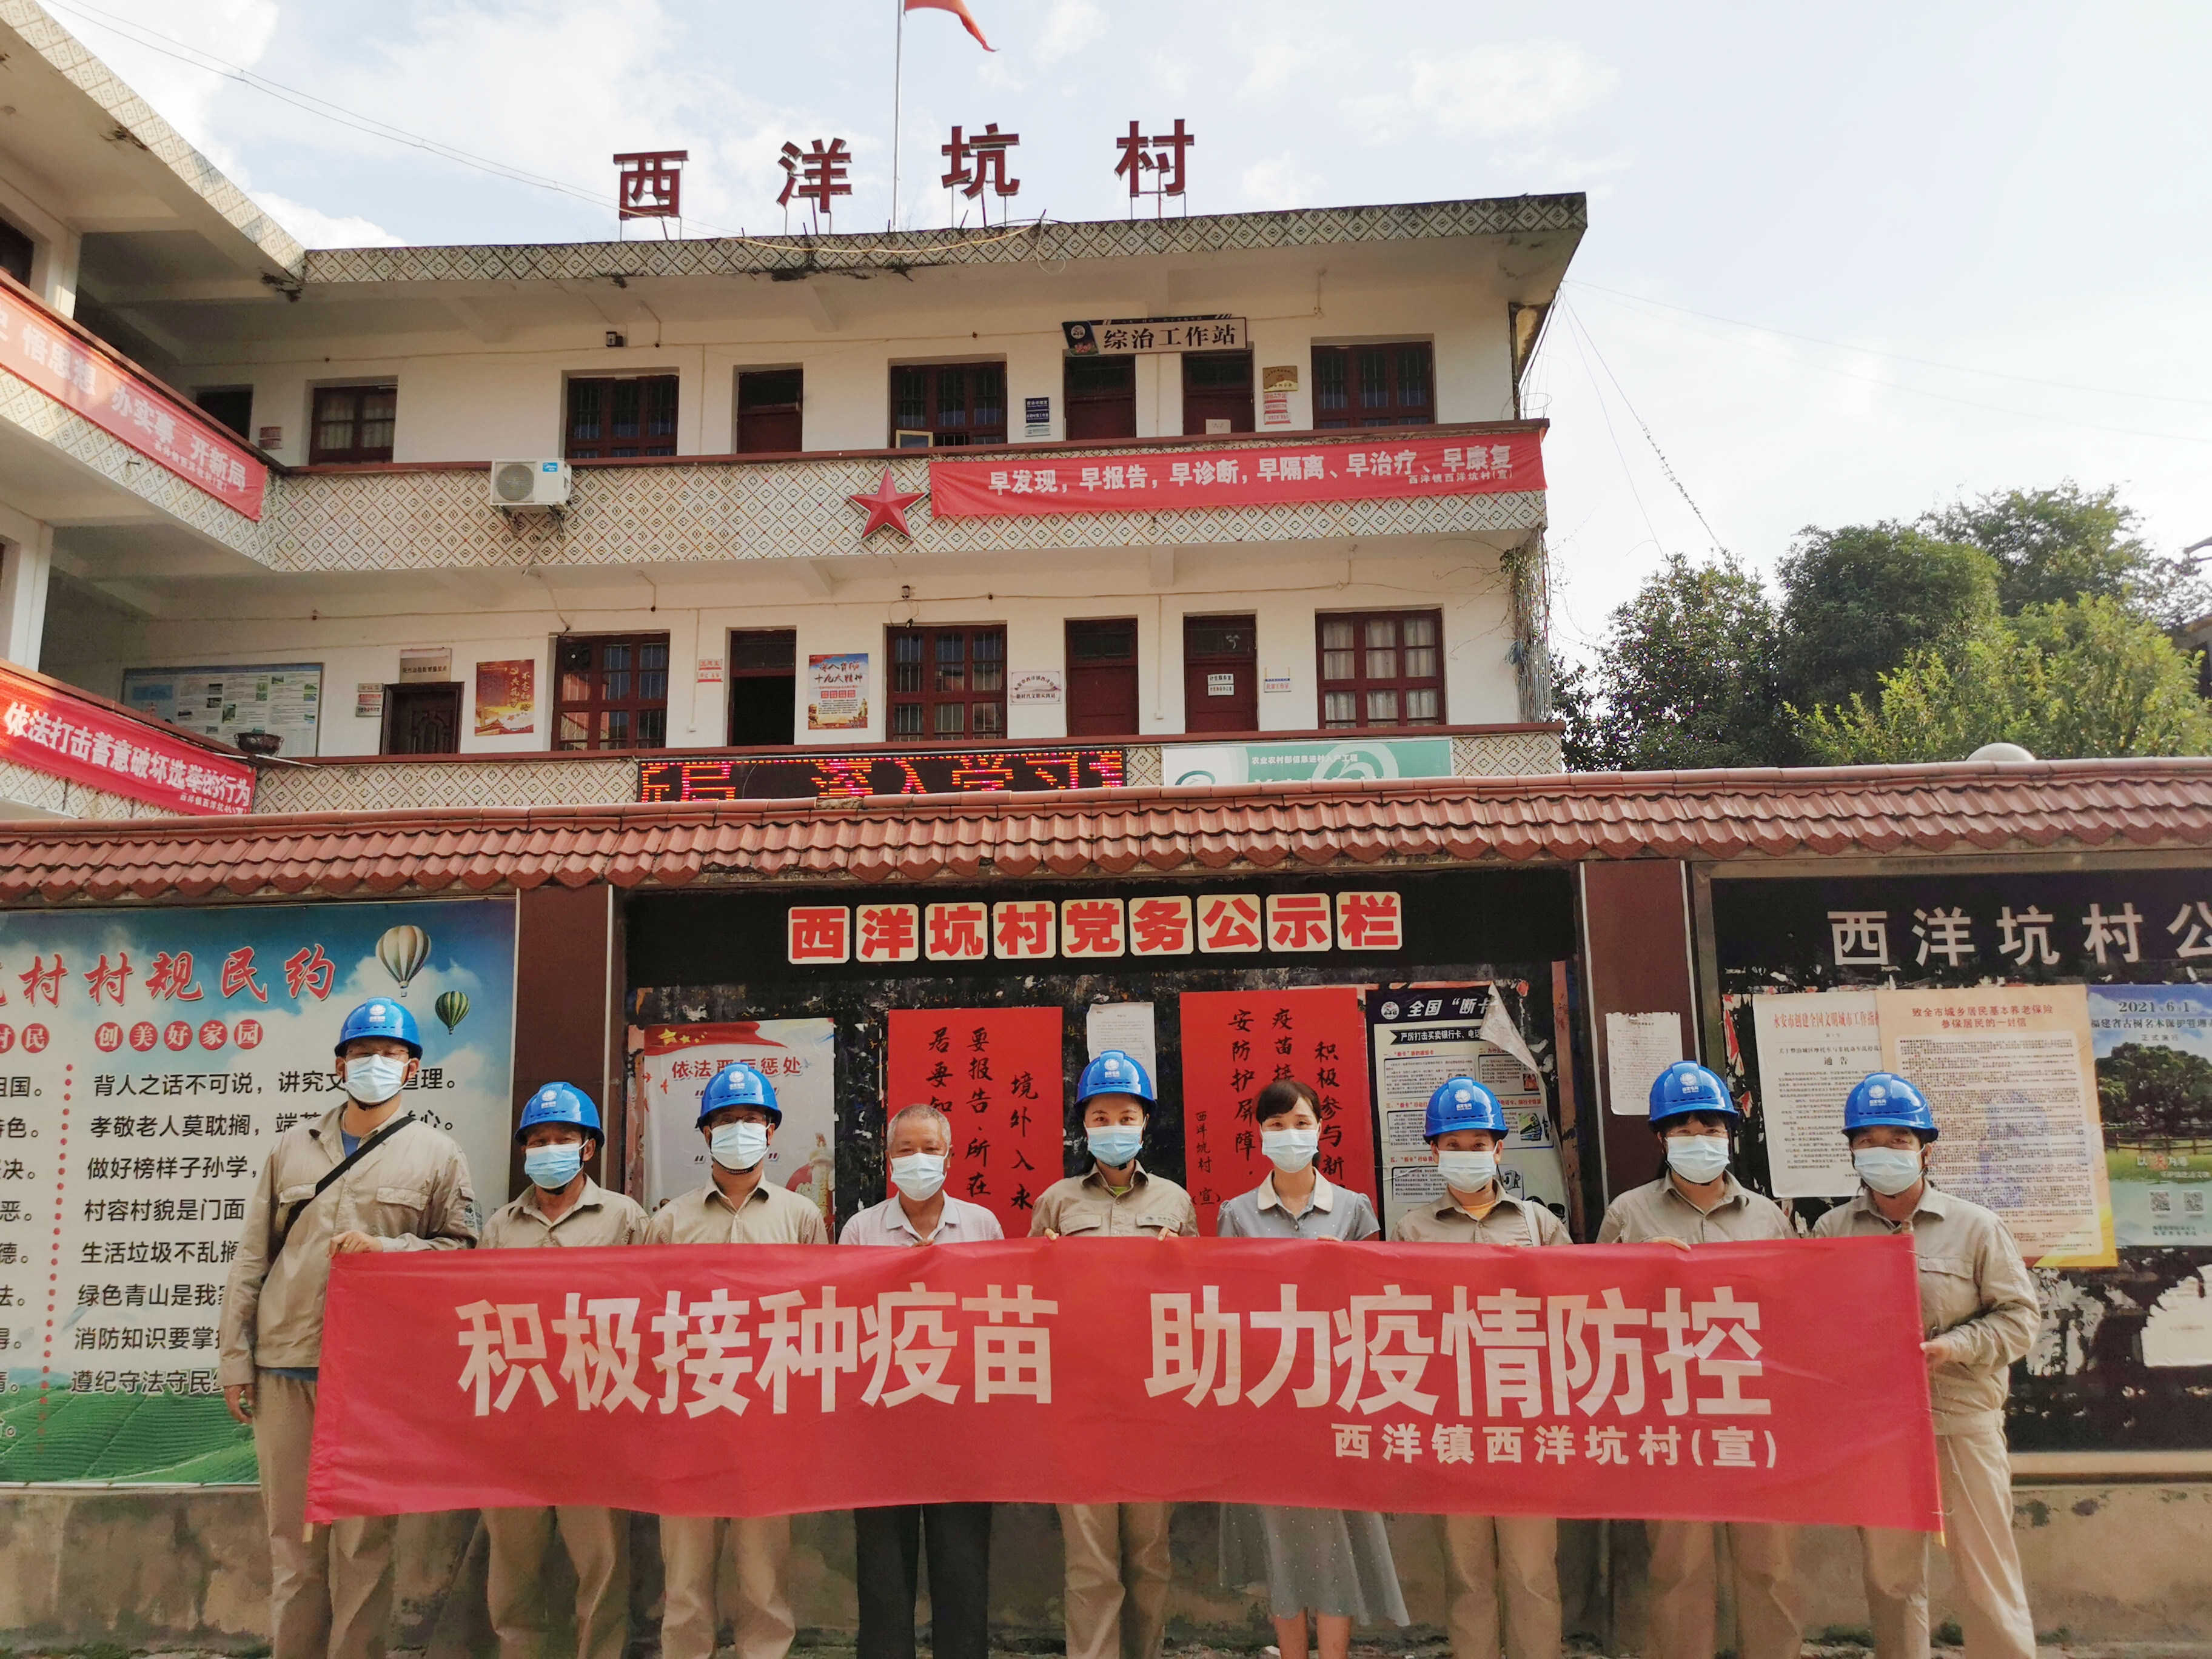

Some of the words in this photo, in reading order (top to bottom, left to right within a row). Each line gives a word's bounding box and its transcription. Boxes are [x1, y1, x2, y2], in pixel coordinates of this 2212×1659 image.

[613, 118, 1195, 221] 西洋坑村
[1104, 323, 1236, 350] 综治工作站
[112, 384, 176, 444] 办实事
[190, 434, 246, 492] 开新局
[4, 701, 252, 807] 依法打击蓄意破坏选举的行为
[791, 894, 1399, 960] 西洋坑村党务公示栏
[0, 944, 335, 1007] 村村规民约
[1912, 1004, 2053, 1017] 致全市城乡居民基本养老保险
[1941, 1017, 2028, 1029] 参保居民的一封信
[96, 1022, 261, 1050] 创美好家园
[1824, 1056, 1848, 1065] 通告
[1315, 1041, 1344, 1182] 积极参与新
[0, 1117, 38, 1138] 色。
[0, 1159, 35, 1180] 决。
[87, 1156, 258, 1180] 做好榜样子孙学，
[84, 1198, 246, 1222] 村容村貌是门面
[78, 1284, 225, 1307] 绿色青山是我
[74, 1327, 222, 1350] 消防知识要掌
[455, 1282, 1059, 1418] 积极接种疫苗
[1143, 1282, 1772, 1419] 助力疫情防控
[1330, 1423, 1777, 1469] 西洋镇西洋坑村(宣)
